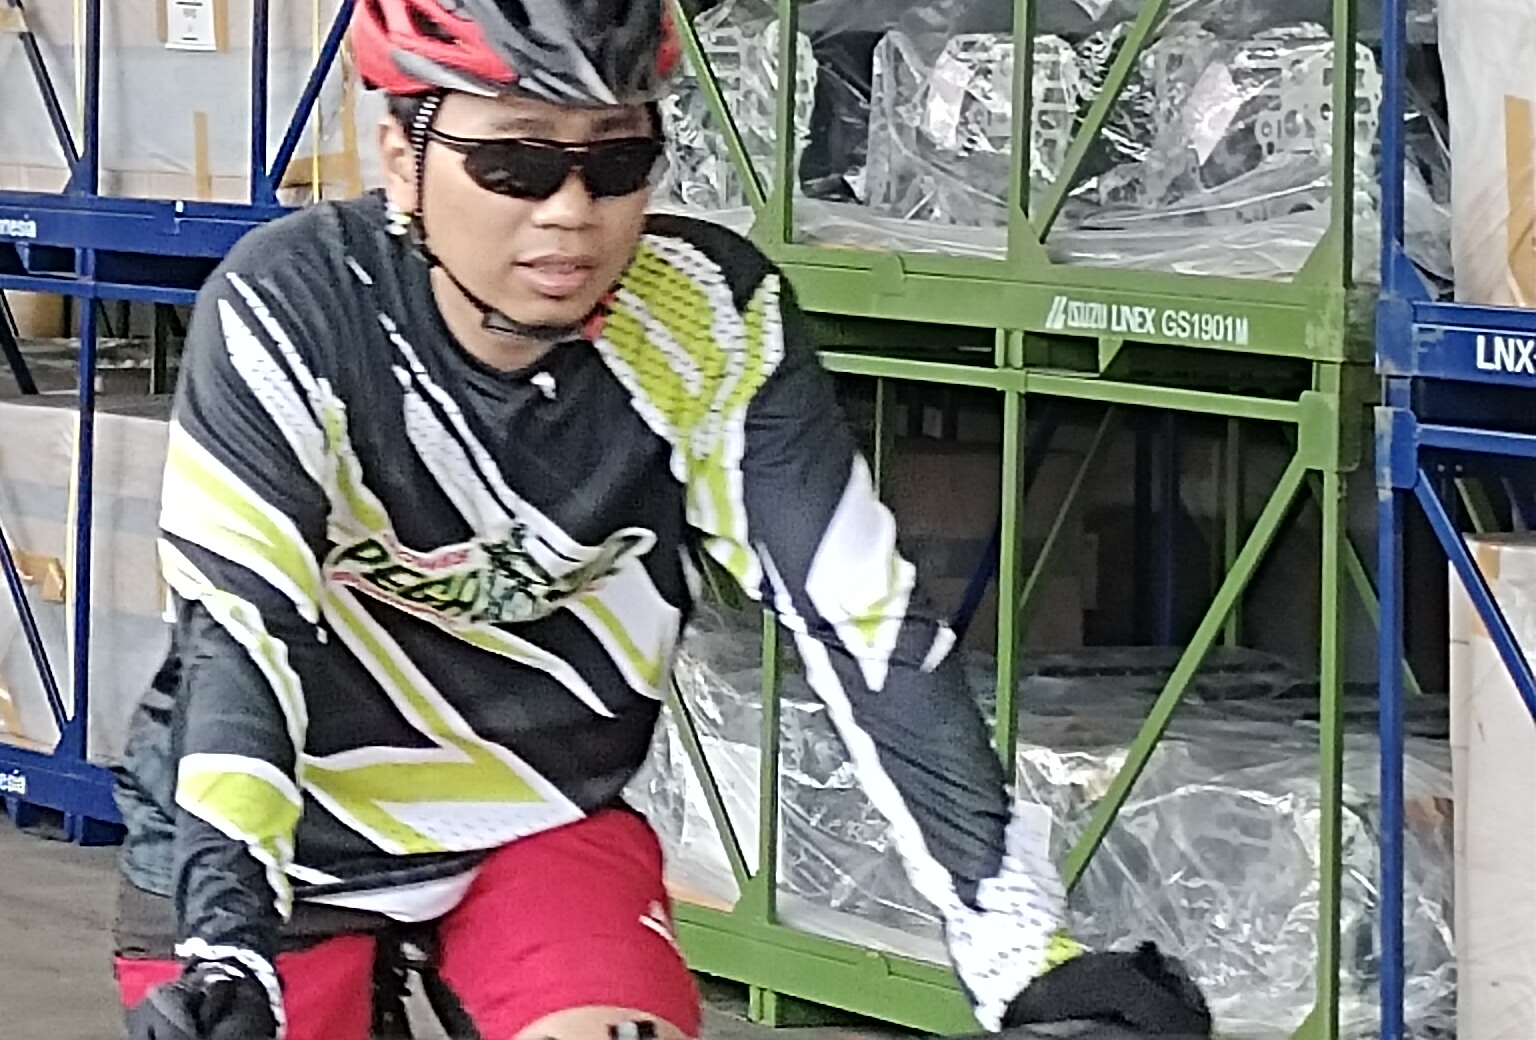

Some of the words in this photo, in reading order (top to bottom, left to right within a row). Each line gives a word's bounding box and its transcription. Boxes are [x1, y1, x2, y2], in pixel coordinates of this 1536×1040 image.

[1067, 300, 1107, 329] ISUZU
[1111, 304, 1156, 335] LINEX
[1161, 309, 1248, 345] GS1901M
